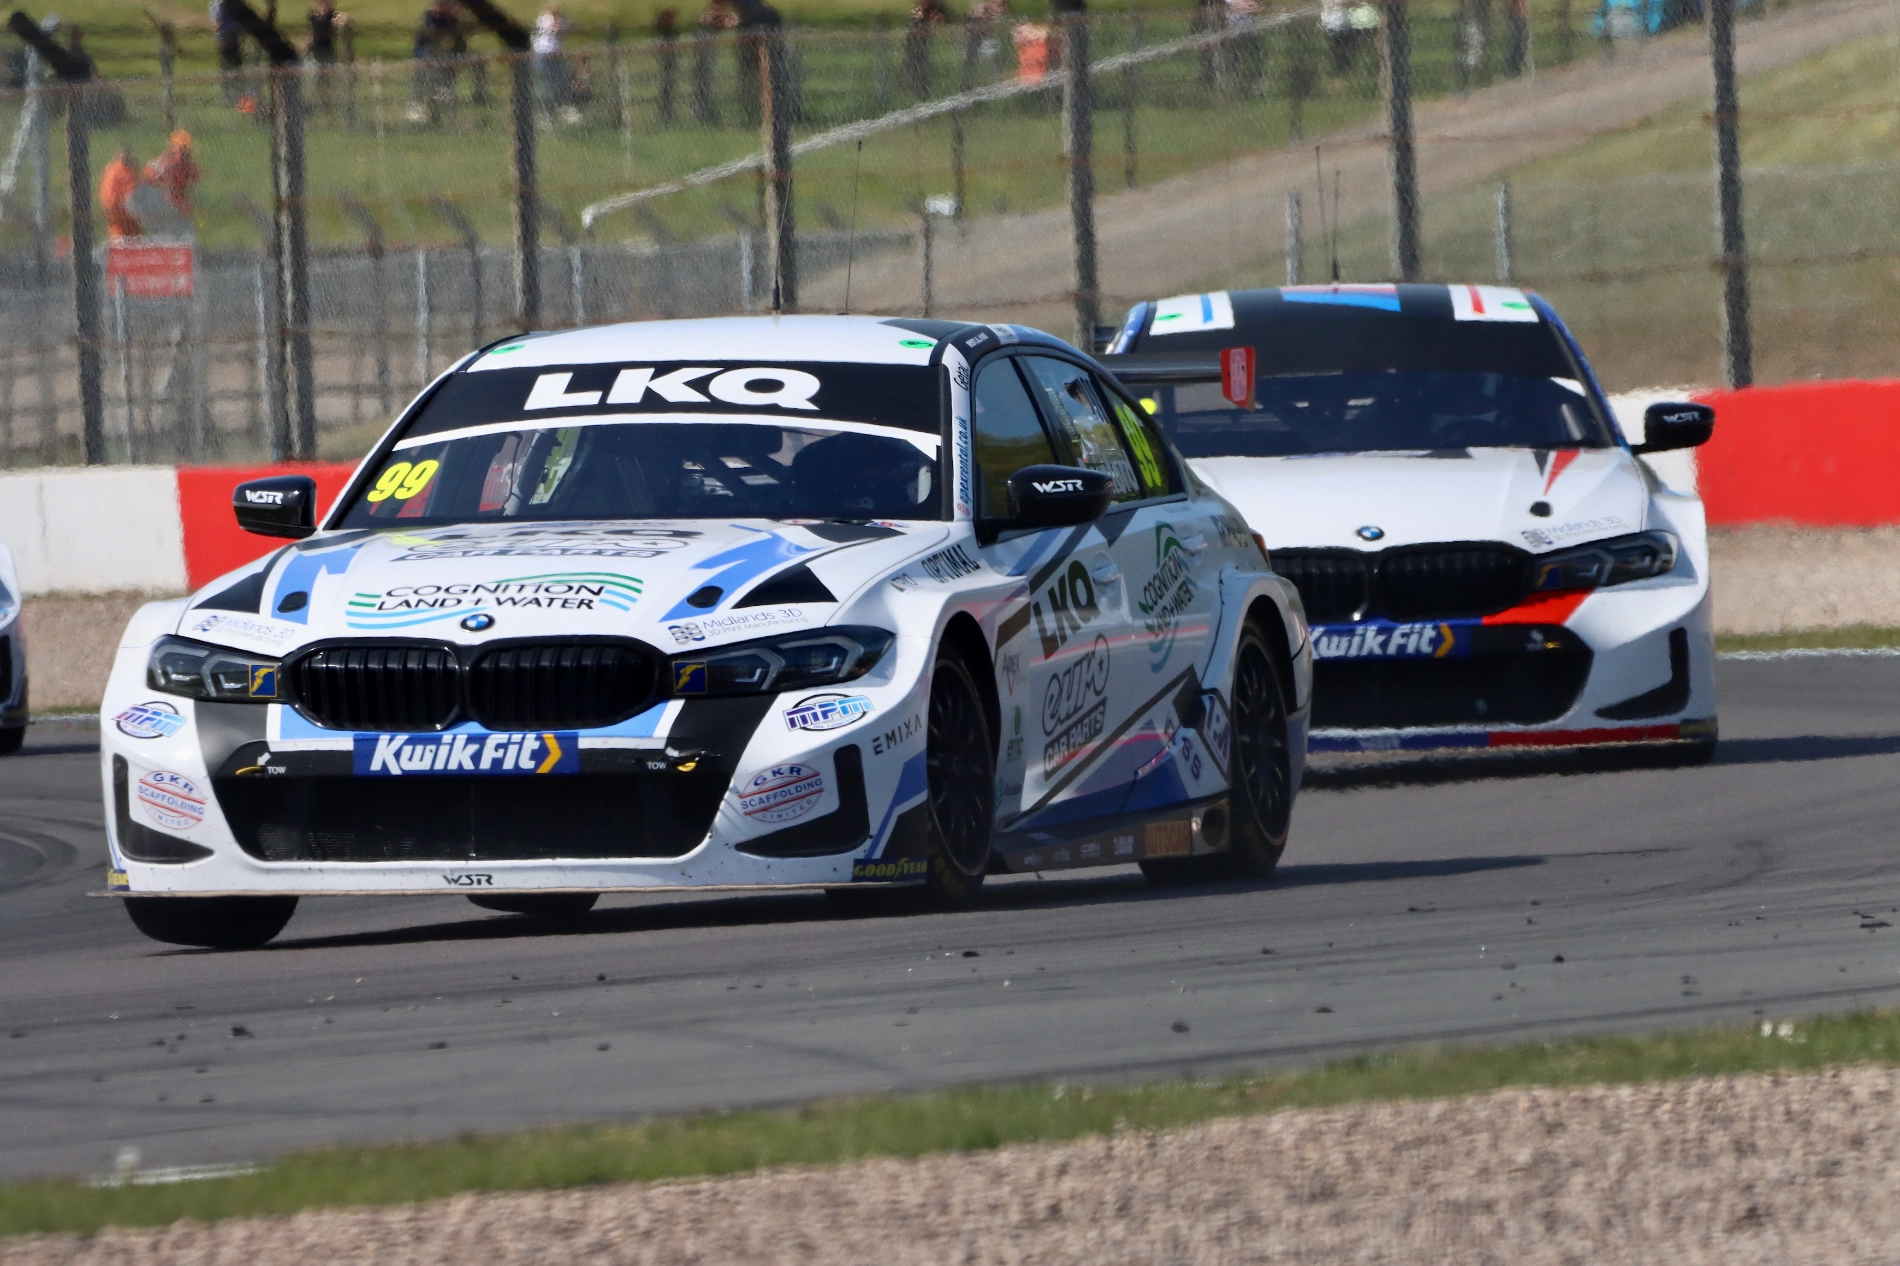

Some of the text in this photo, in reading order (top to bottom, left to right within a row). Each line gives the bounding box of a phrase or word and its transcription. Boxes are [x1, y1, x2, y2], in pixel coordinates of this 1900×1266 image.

[524, 367, 821, 411] LKQ
[367, 460, 439, 502] 99
[1032, 479, 1083, 494] WSR
[245, 490, 283, 505] WSR
[921, 544, 981, 583] OPTIMAL
[386, 583, 605, 597] COGNITION
[1143, 548, 1183, 612] COGNITION
[377, 598, 461, 611] LAND
[493, 597, 594, 610] WATER
[1032, 560, 1101, 661] LKQ
[703, 608, 802, 629] Midlands 3D
[267, 766, 286, 775] TOW
[647, 762, 667, 770] TOW
[754, 766, 802, 787] GKR
[153, 772, 194, 794] GKR
[138, 785, 205, 815] SCAFFOLDING
[741, 778, 823, 810] SCAFFOLDING
[443, 874, 493, 886] WSR
